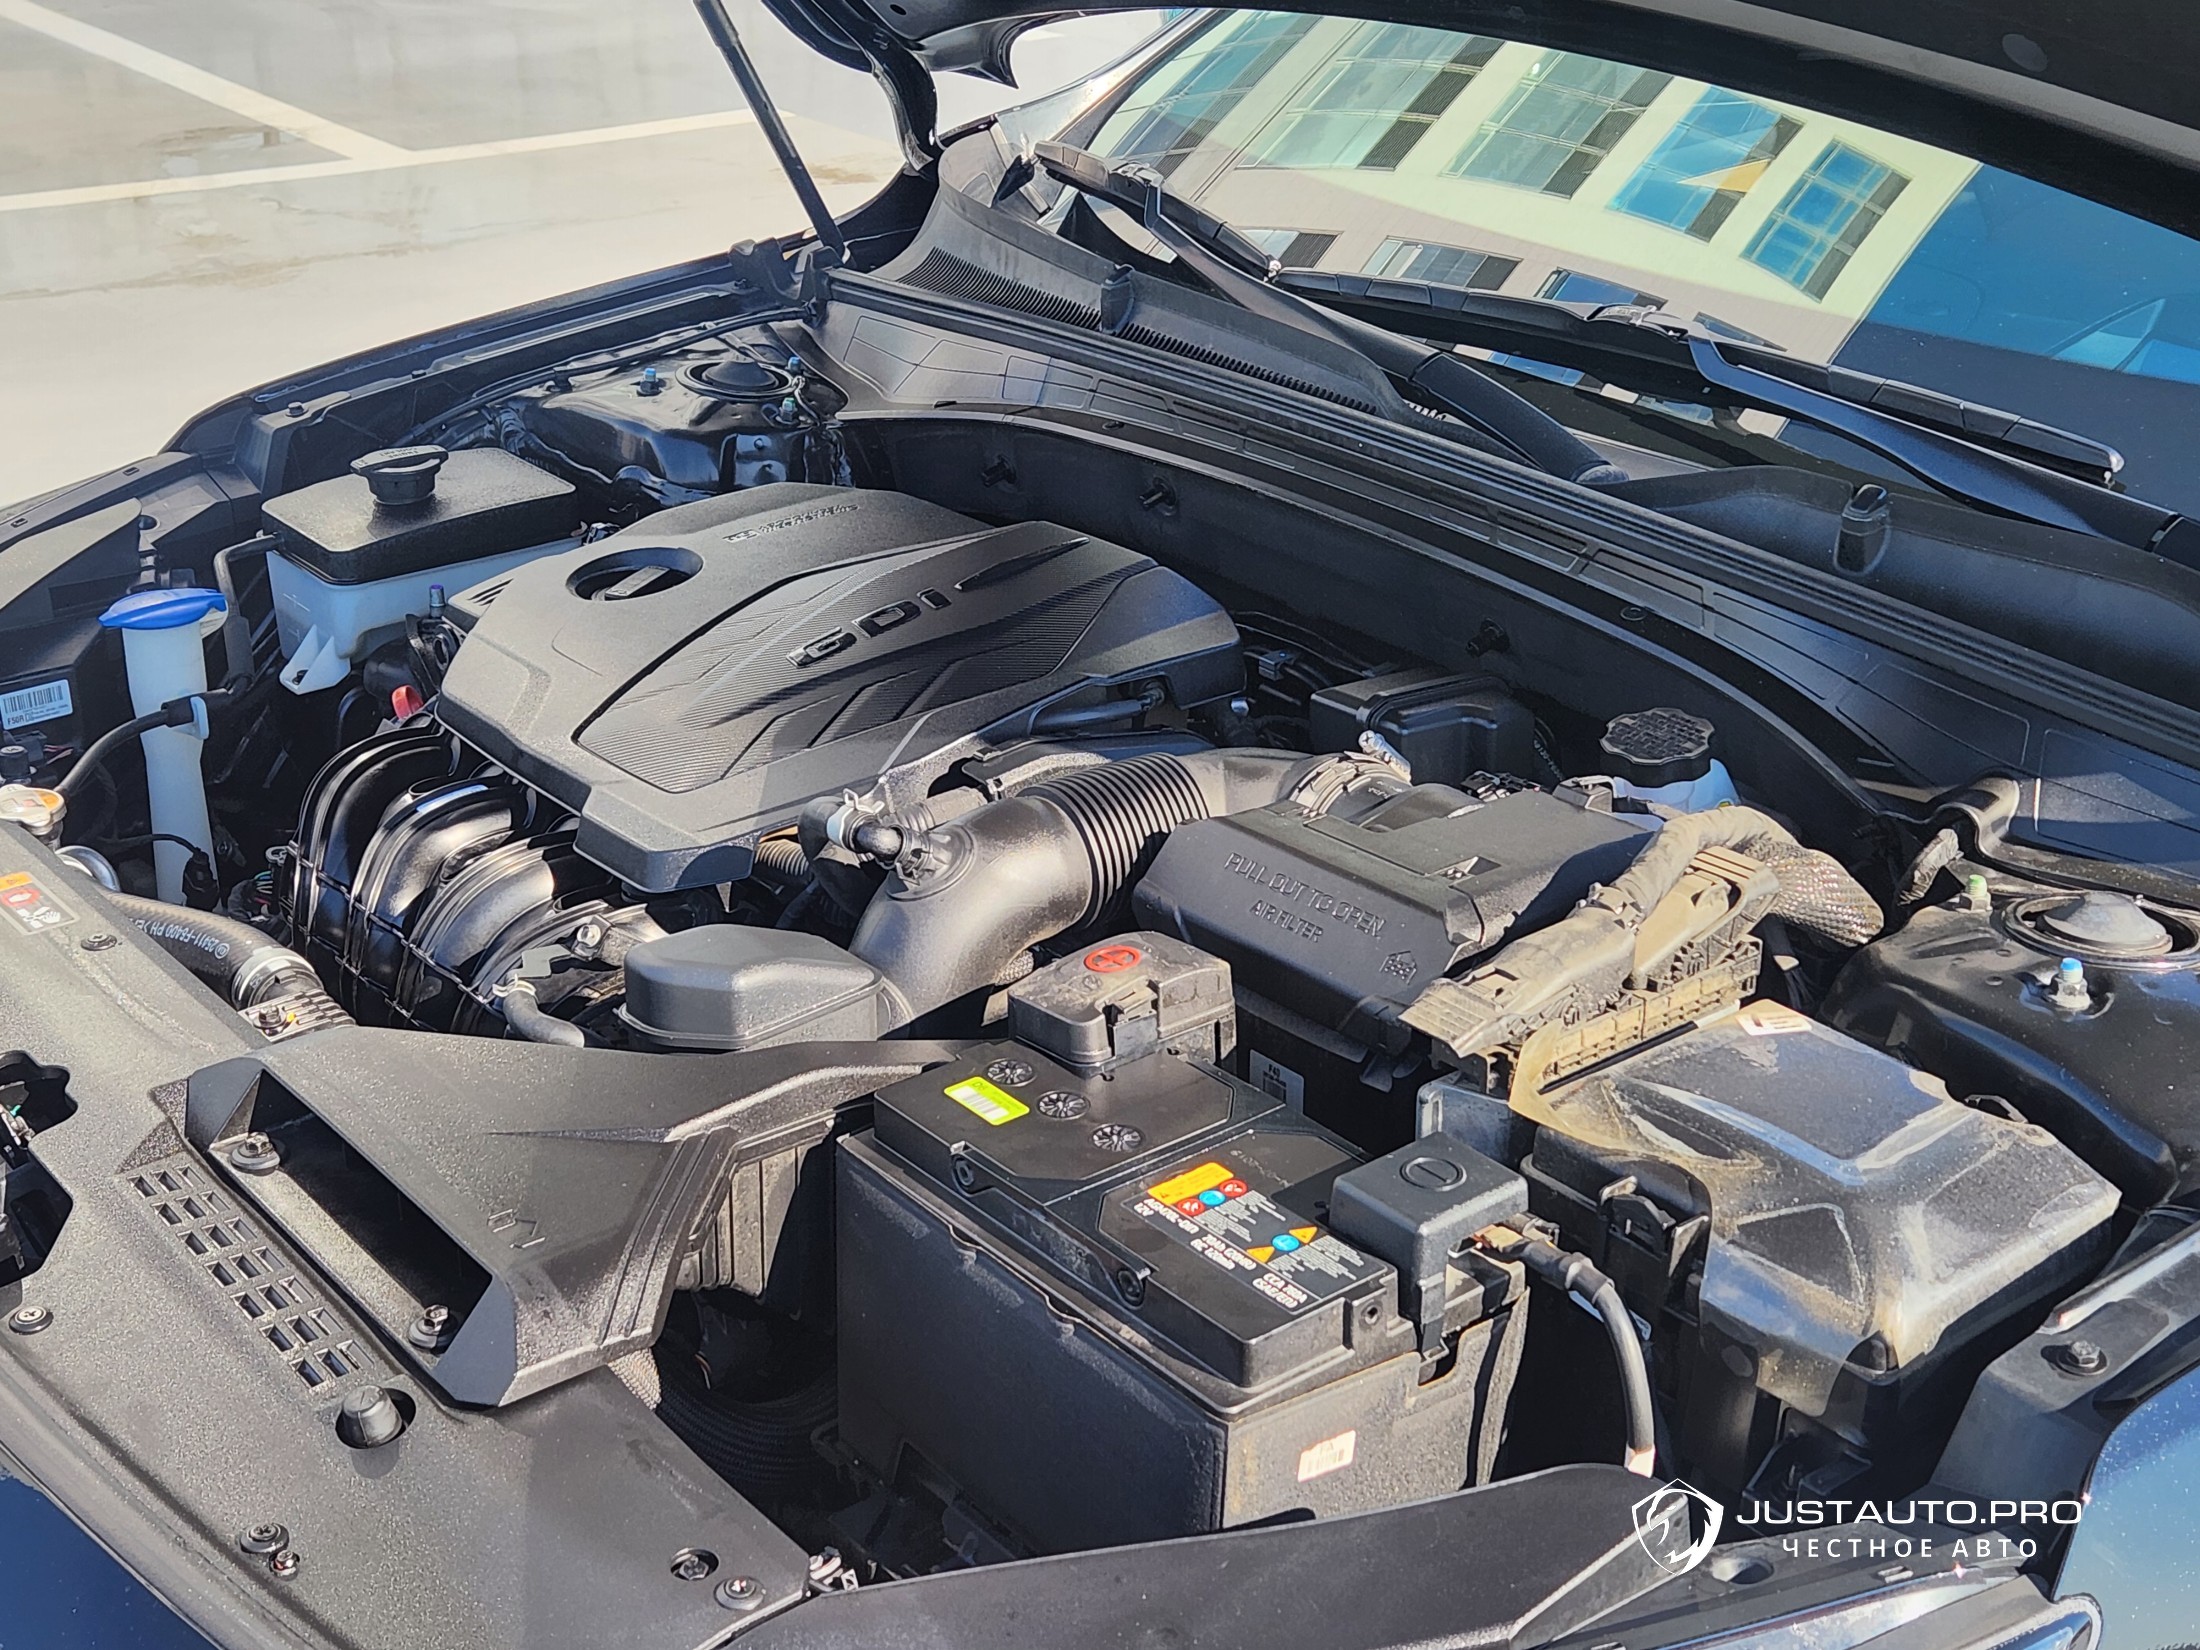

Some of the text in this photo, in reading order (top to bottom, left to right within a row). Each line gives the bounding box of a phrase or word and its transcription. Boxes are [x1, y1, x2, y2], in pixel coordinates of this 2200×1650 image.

[1224, 852, 1387, 938] PULL OUT TO OPEN
[1250, 900, 1324, 943] AIR FILTER
